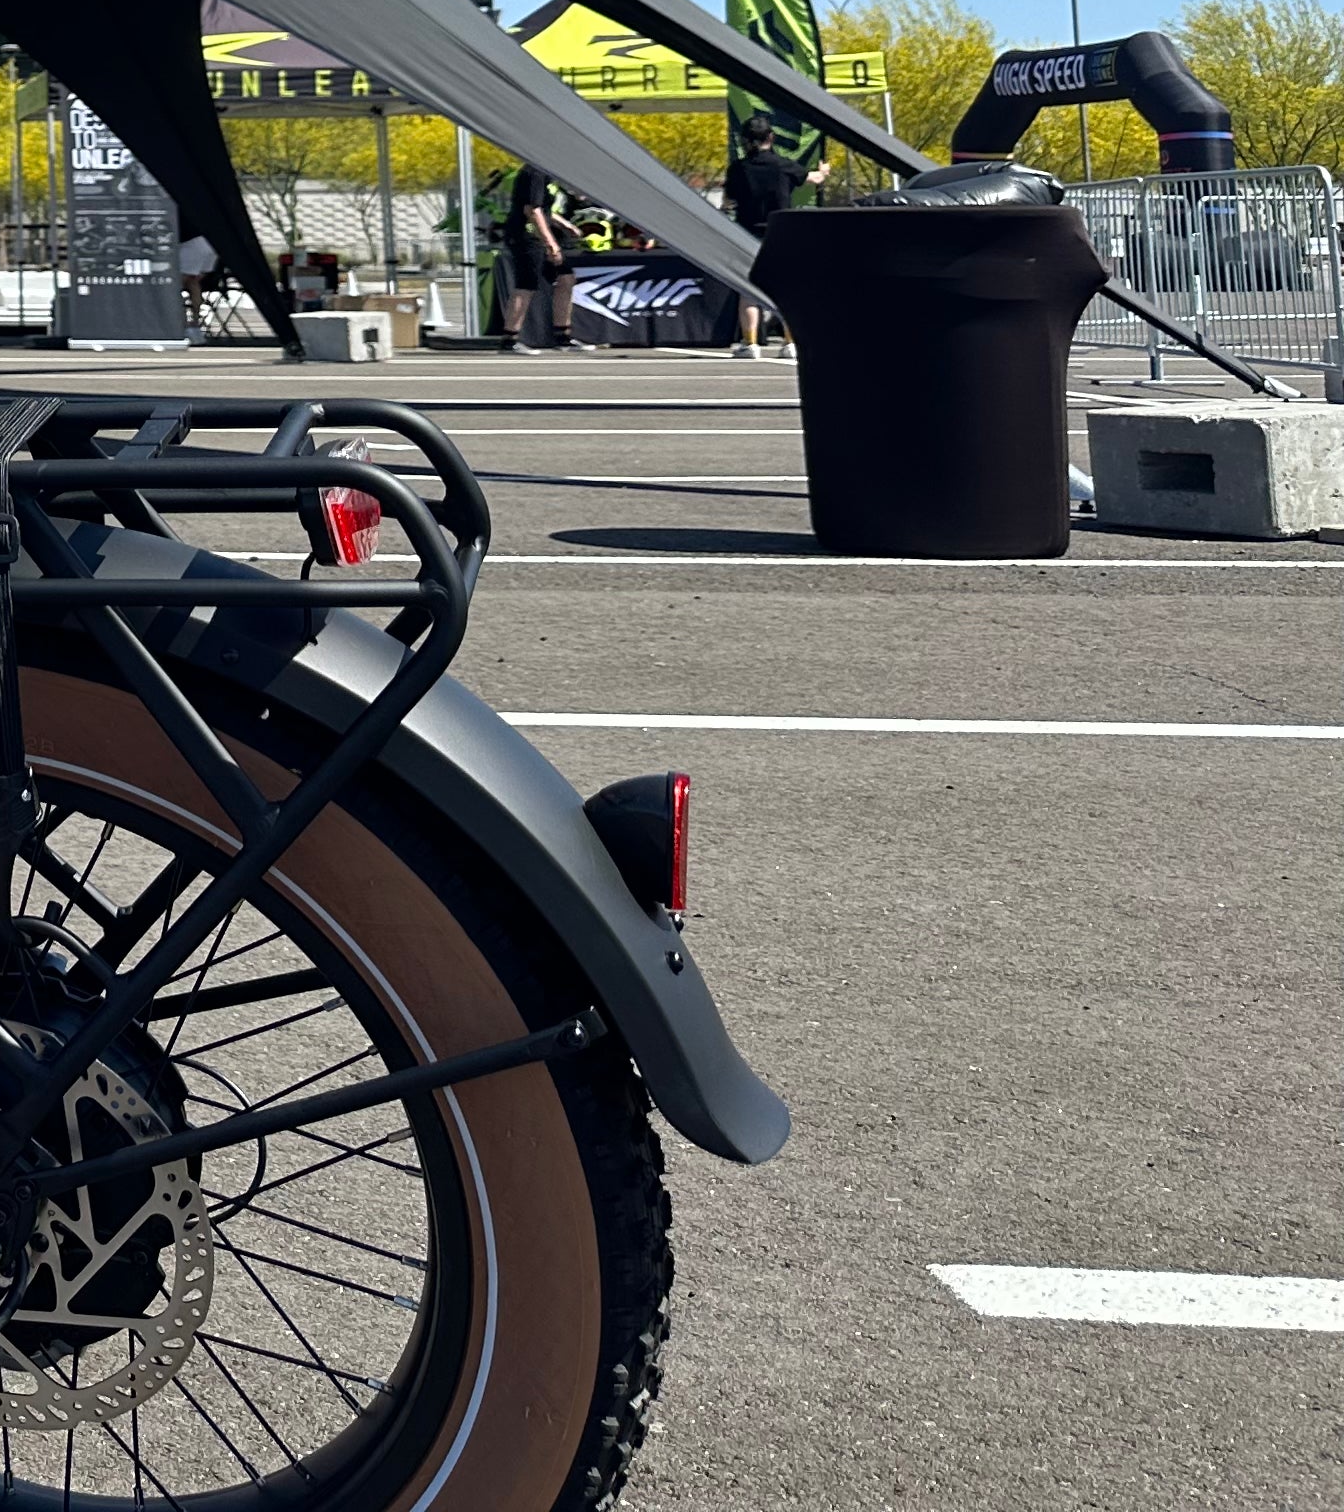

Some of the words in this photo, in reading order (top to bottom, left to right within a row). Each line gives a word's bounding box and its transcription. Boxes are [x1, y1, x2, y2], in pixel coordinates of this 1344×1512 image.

[993, 60, 1033, 97] HIGH
[1033, 54, 1086, 95] SPEED
[71, 129, 97, 150] TO
